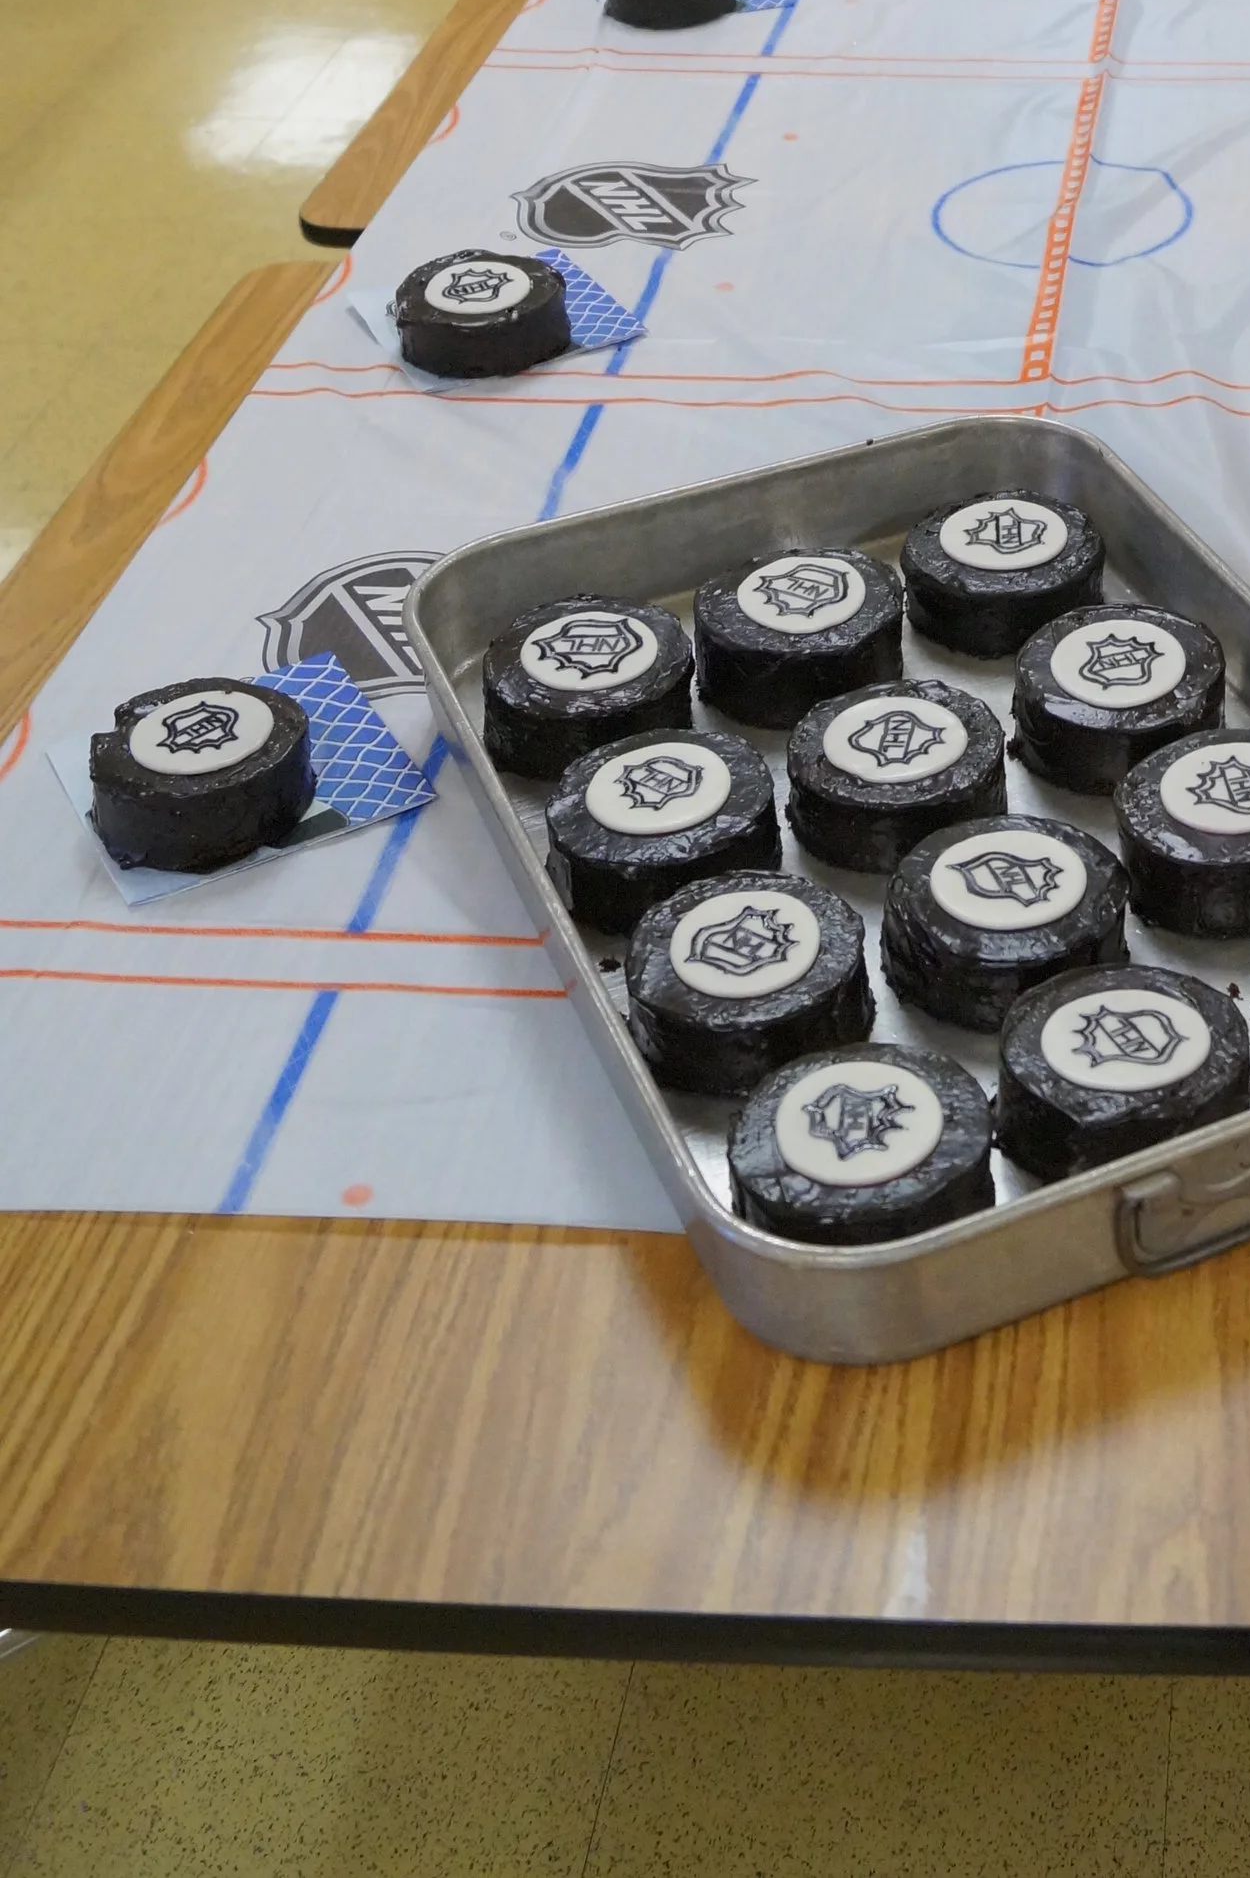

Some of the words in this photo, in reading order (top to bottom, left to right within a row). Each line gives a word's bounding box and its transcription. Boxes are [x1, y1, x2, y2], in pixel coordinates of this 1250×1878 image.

[578, 181, 673, 230] NHL
[1001, 519, 1020, 544] NHL
[786, 577, 830, 599] NHL
[561, 636, 622, 652] NHL
[1099, 652, 1145, 670] NHL
[883, 720, 911, 752] NHL
[639, 768, 682, 792] NHL
[1110, 1019, 1150, 1053] NHL
